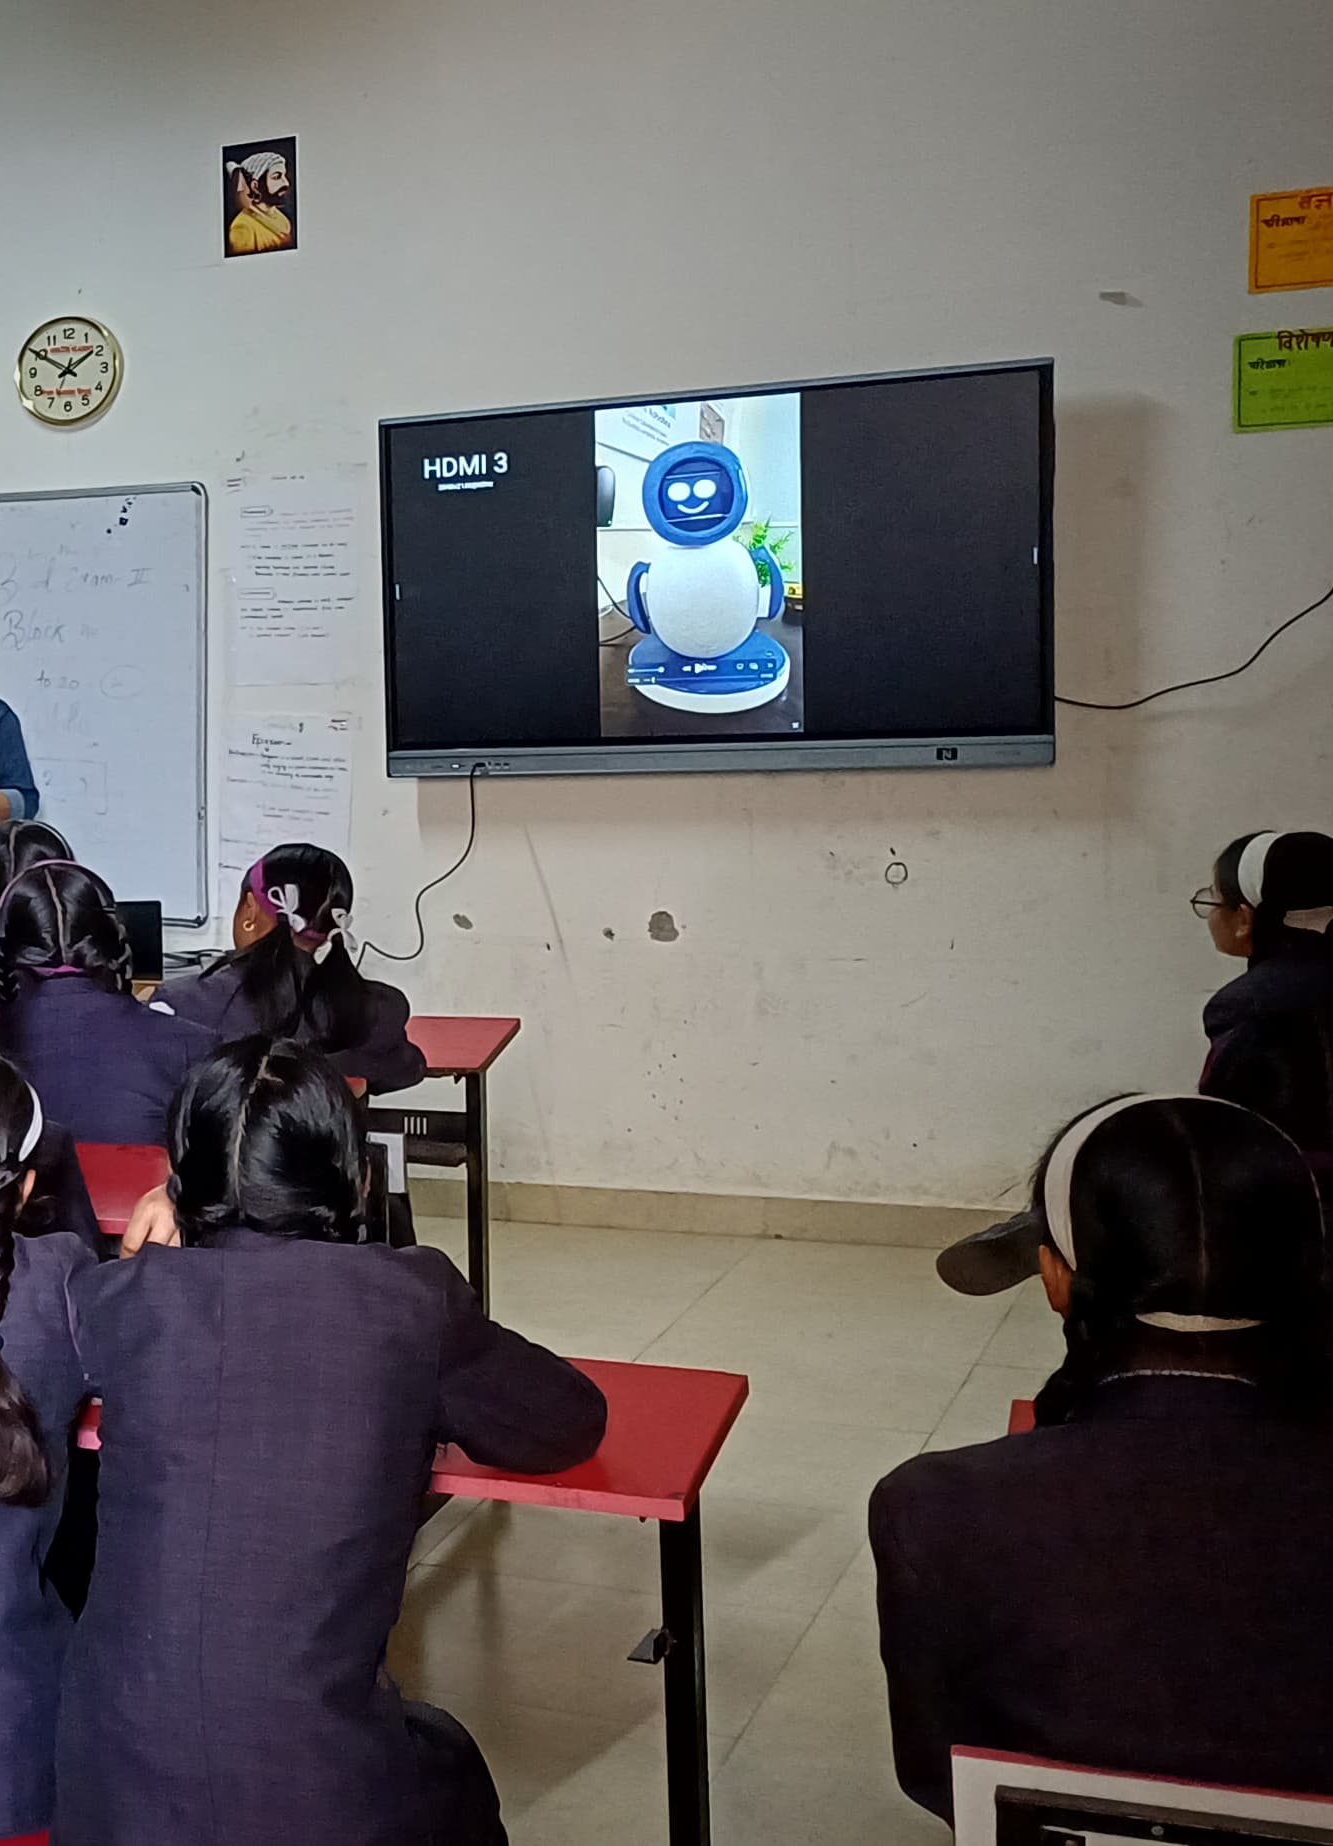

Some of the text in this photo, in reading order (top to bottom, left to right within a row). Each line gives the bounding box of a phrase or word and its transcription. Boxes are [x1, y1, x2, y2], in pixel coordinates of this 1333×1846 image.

[63, 327, 75, 339] 12
[84, 332, 89, 343] 1
[47, 335, 56, 346] 11
[95, 345, 104, 356] 2
[29, 367, 37, 378] 9
[100, 361, 109, 373] 3
[34, 385, 43, 396] 8
[94, 381, 103, 392] 4
[47, 397, 55, 408] 7
[81, 394, 90, 406] 5
[63, 401, 72, 412] 6
[423, 451, 508, 479] HDMI 3
